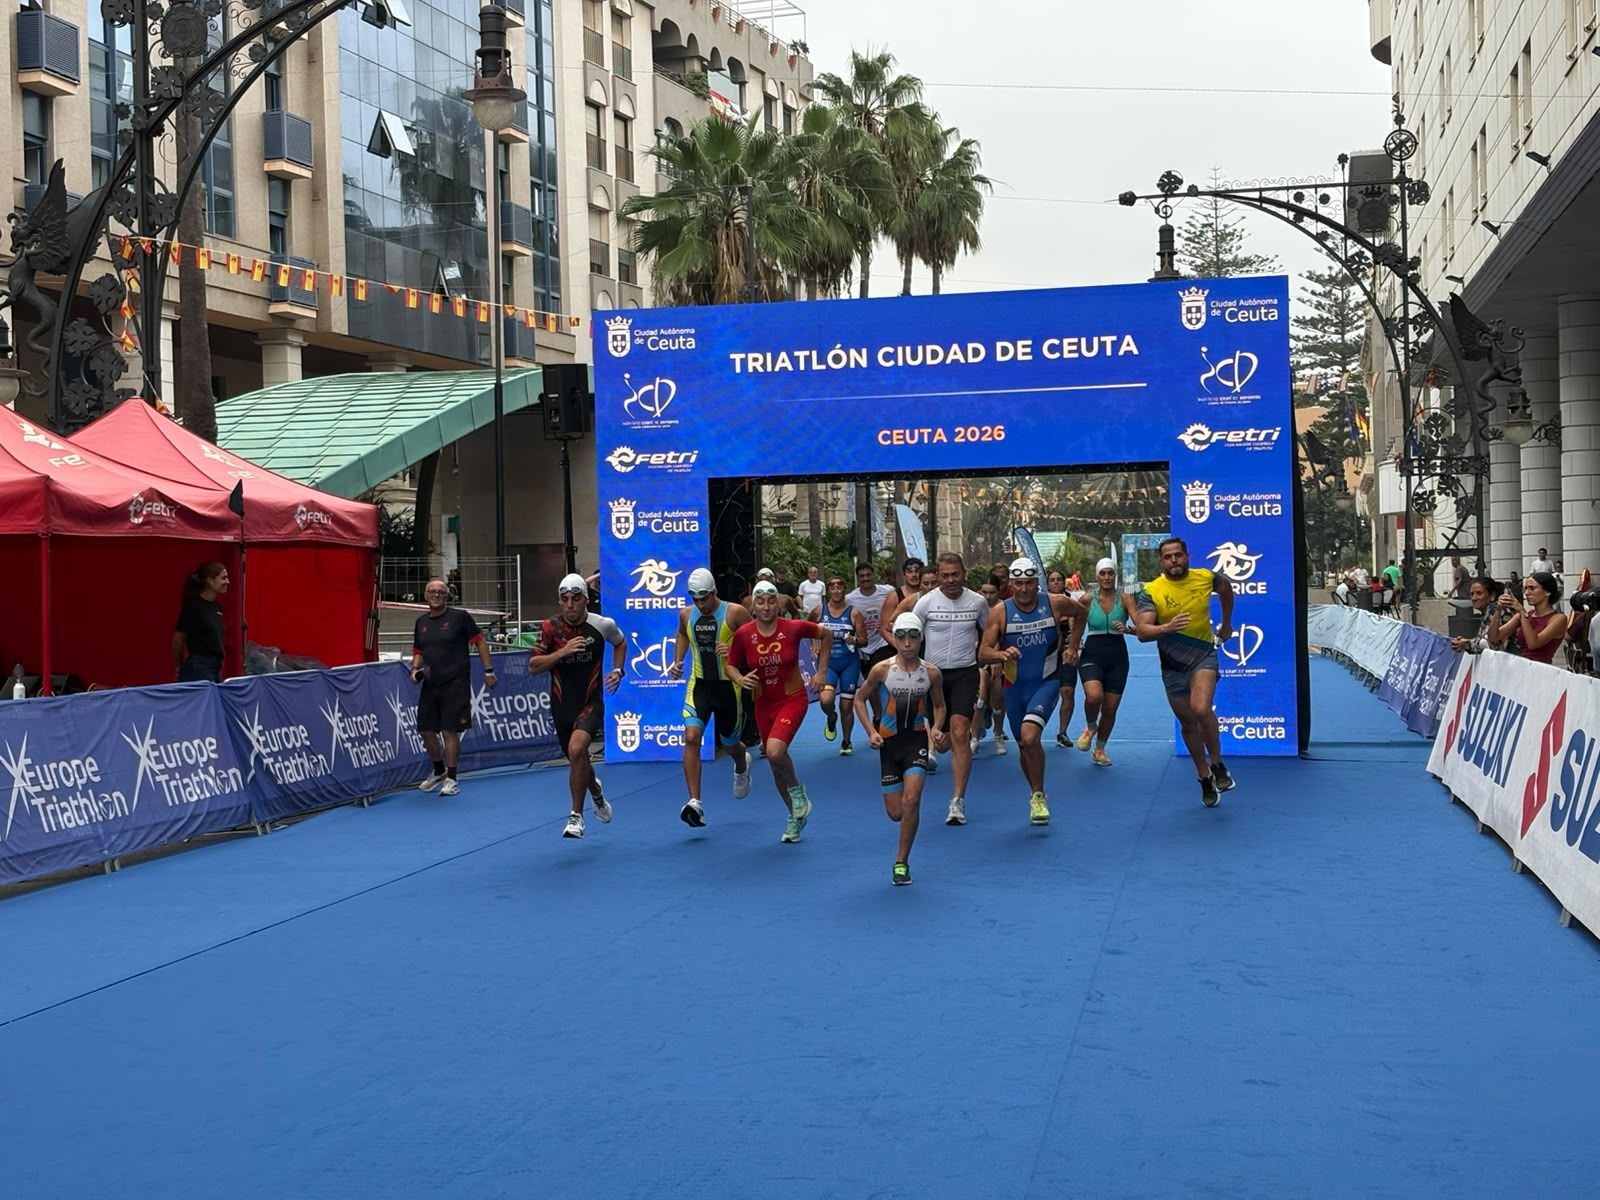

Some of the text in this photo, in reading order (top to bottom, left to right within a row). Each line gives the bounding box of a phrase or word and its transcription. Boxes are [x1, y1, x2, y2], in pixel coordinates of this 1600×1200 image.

[1210, 298, 1278, 308] Ciudad Autónoma
[1210, 307, 1279, 323] de Ceuta
[634, 327, 696, 337] Ciudad Autónoma
[647, 335, 696, 351] Ceuta
[729, 335, 1139, 374] TRIATLÓN CIUDAD DE CEUTA
[878, 425, 1006, 446] CEUTA 2026
[1242, 492, 1281, 500] Autónoma
[637, 510, 698, 519] Ciudad Autónoma
[1228, 501, 1282, 517] Ceuta
[651, 518, 699, 533] Ceuta
[1231, 581, 1267, 594] RICE
[626, 597, 686, 610] FETRICE
[1017, 632, 1048, 648] OCAÑA
[759, 653, 782, 667] OCAÑA
[765, 666, 779, 676] ESP
[482, 691, 551, 715] Europe
[398, 702, 419, 729] Eur
[1218, 715, 1285, 724] Ciudad Autónoma
[338, 712, 380, 739] Europe
[484, 713, 556, 742] Triathl
[643, 723, 686, 732] Ciudad Autó
[1232, 724, 1285, 739] Ceuta
[256, 724, 311, 754] Europe
[643, 732, 654, 740] de
[1457, 682, 1529, 789] SUZUKI
[148, 736, 219, 771] Europe
[24, 756, 101, 793] Europe
[155, 765, 243, 806] Triathlon
[31, 790, 129, 833] Triathlon
